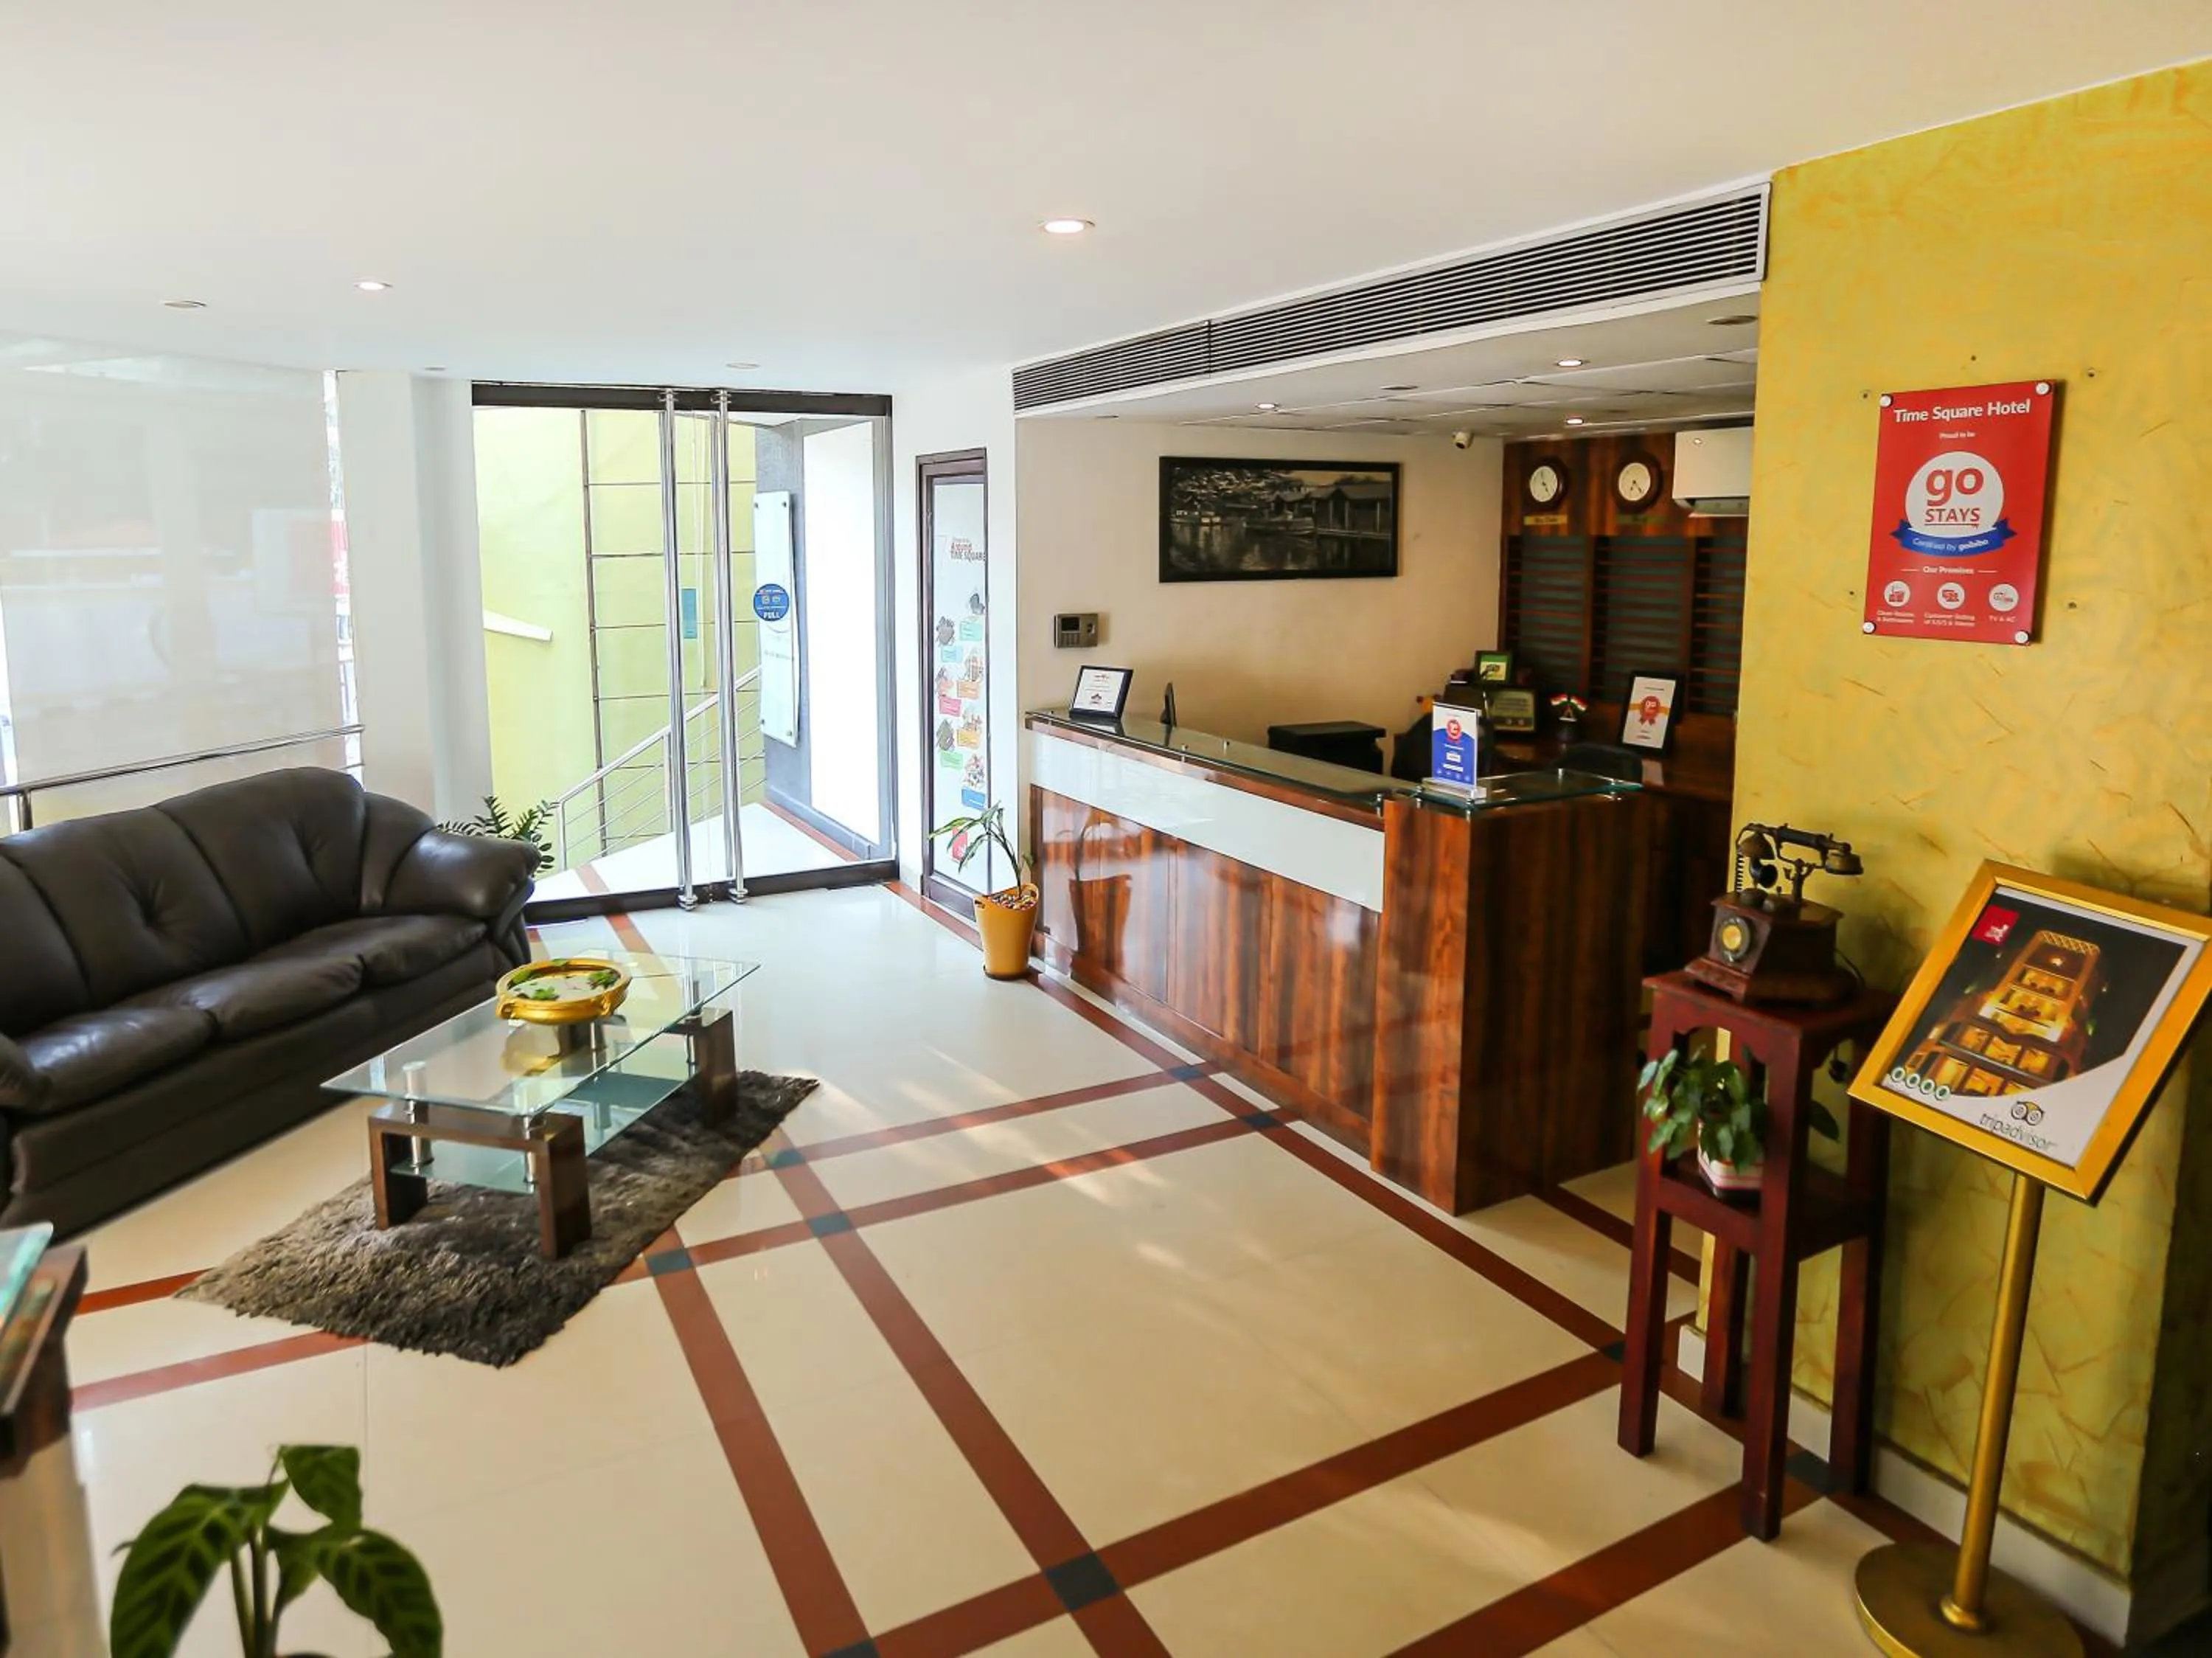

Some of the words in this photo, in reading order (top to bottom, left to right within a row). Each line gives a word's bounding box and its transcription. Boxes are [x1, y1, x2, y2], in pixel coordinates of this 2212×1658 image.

[1893, 409, 1929, 423] Time
[1932, 406, 1983, 422] Square
[1987, 398, 2031, 416] Hotel
[1926, 467, 1984, 507] go
[1924, 507, 1981, 523] STAYS
[1923, 566, 1938, 574] Our
